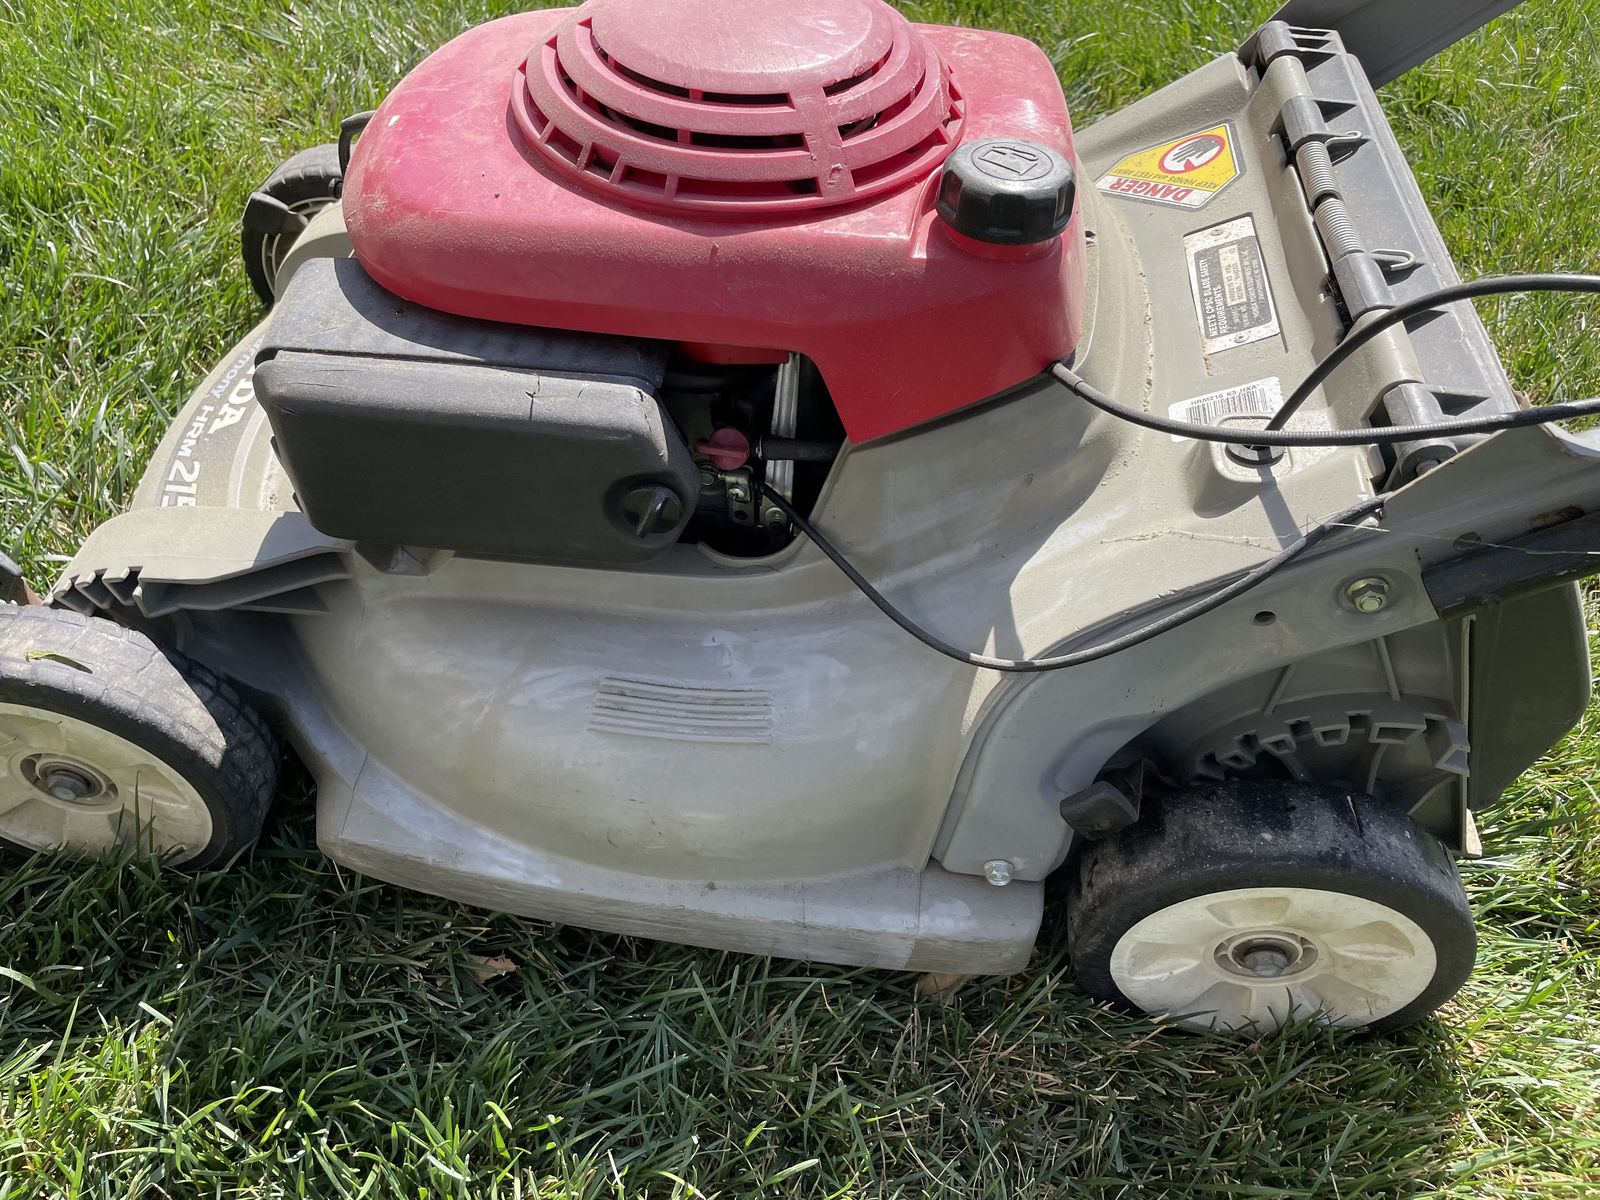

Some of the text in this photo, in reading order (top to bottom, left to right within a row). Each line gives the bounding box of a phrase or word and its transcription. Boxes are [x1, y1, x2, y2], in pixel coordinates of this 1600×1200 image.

[1167, 177, 1196, 185] HANDS
[1195, 181, 1219, 189] KEEP
[1109, 177, 1194, 202] DANGER
[1198, 258, 1218, 337] MEETS CPSC BLADE SAFETY
